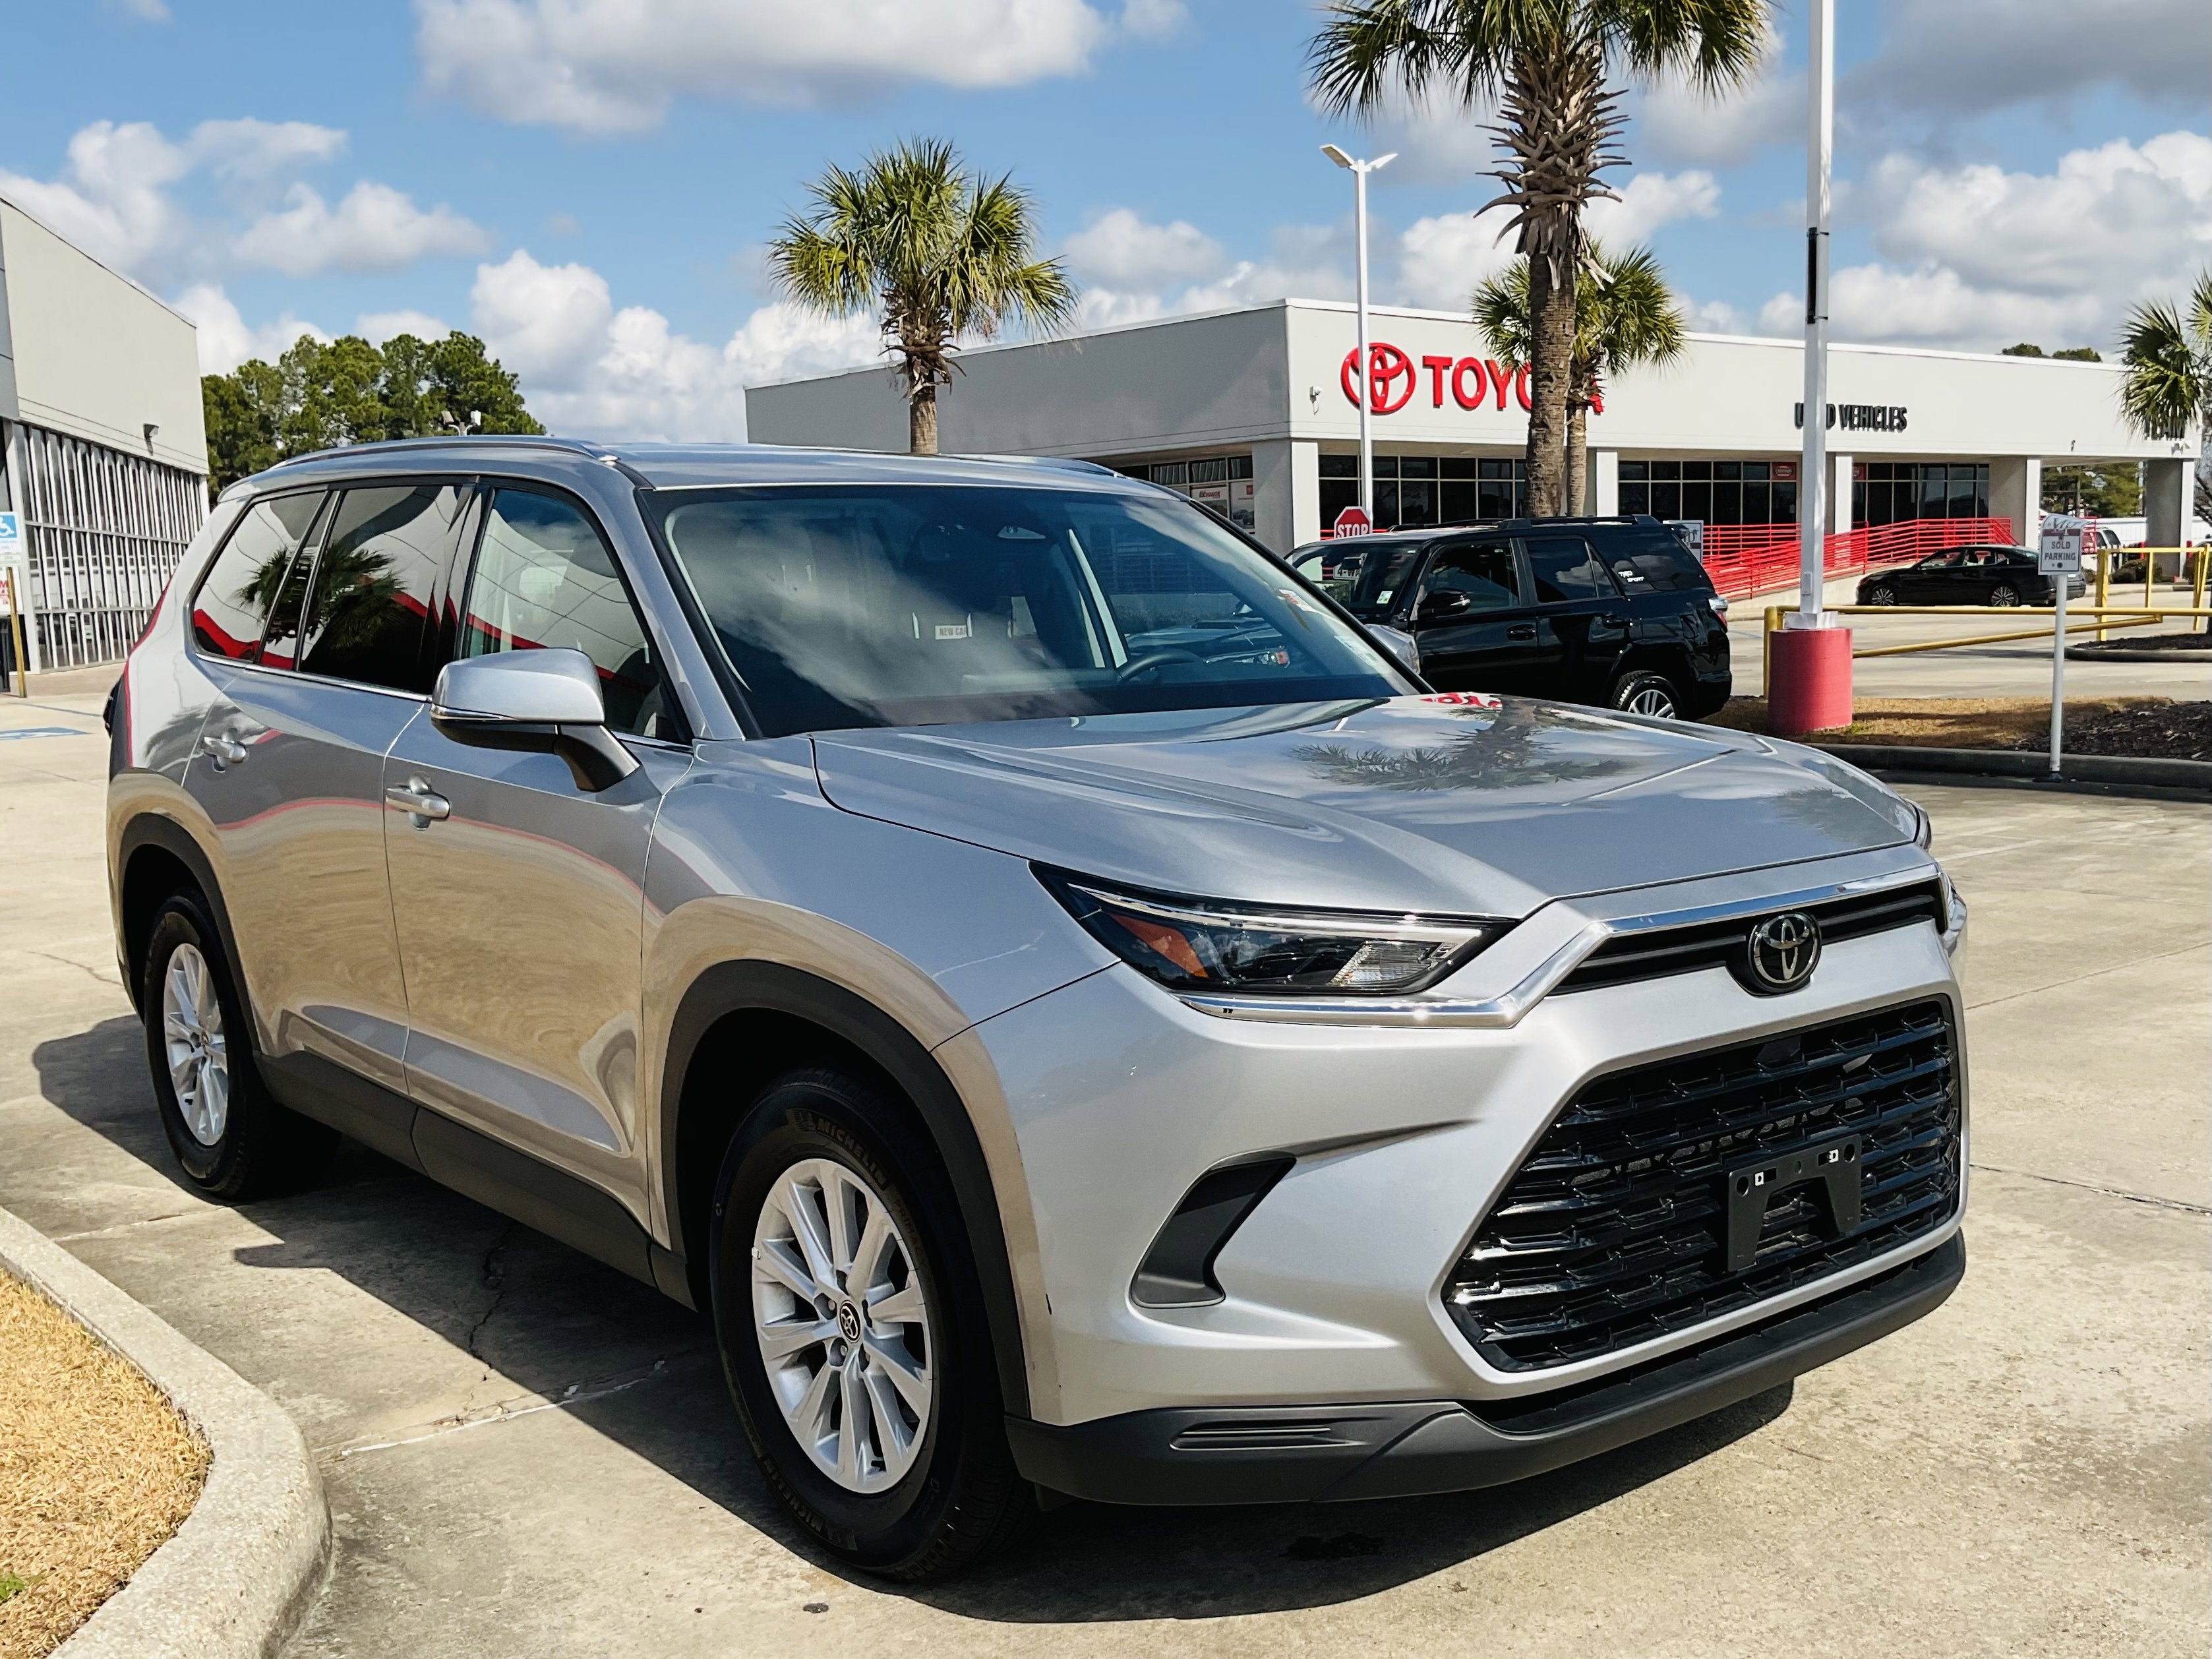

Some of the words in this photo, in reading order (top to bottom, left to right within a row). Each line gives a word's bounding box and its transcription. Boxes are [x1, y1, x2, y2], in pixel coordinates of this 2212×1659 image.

[1794, 402, 1836, 430] UD
[1838, 404, 1907, 433] VEHICLES
[1338, 524, 1369, 538] STOP
[816, 1118, 887, 1190] MICHELIN
